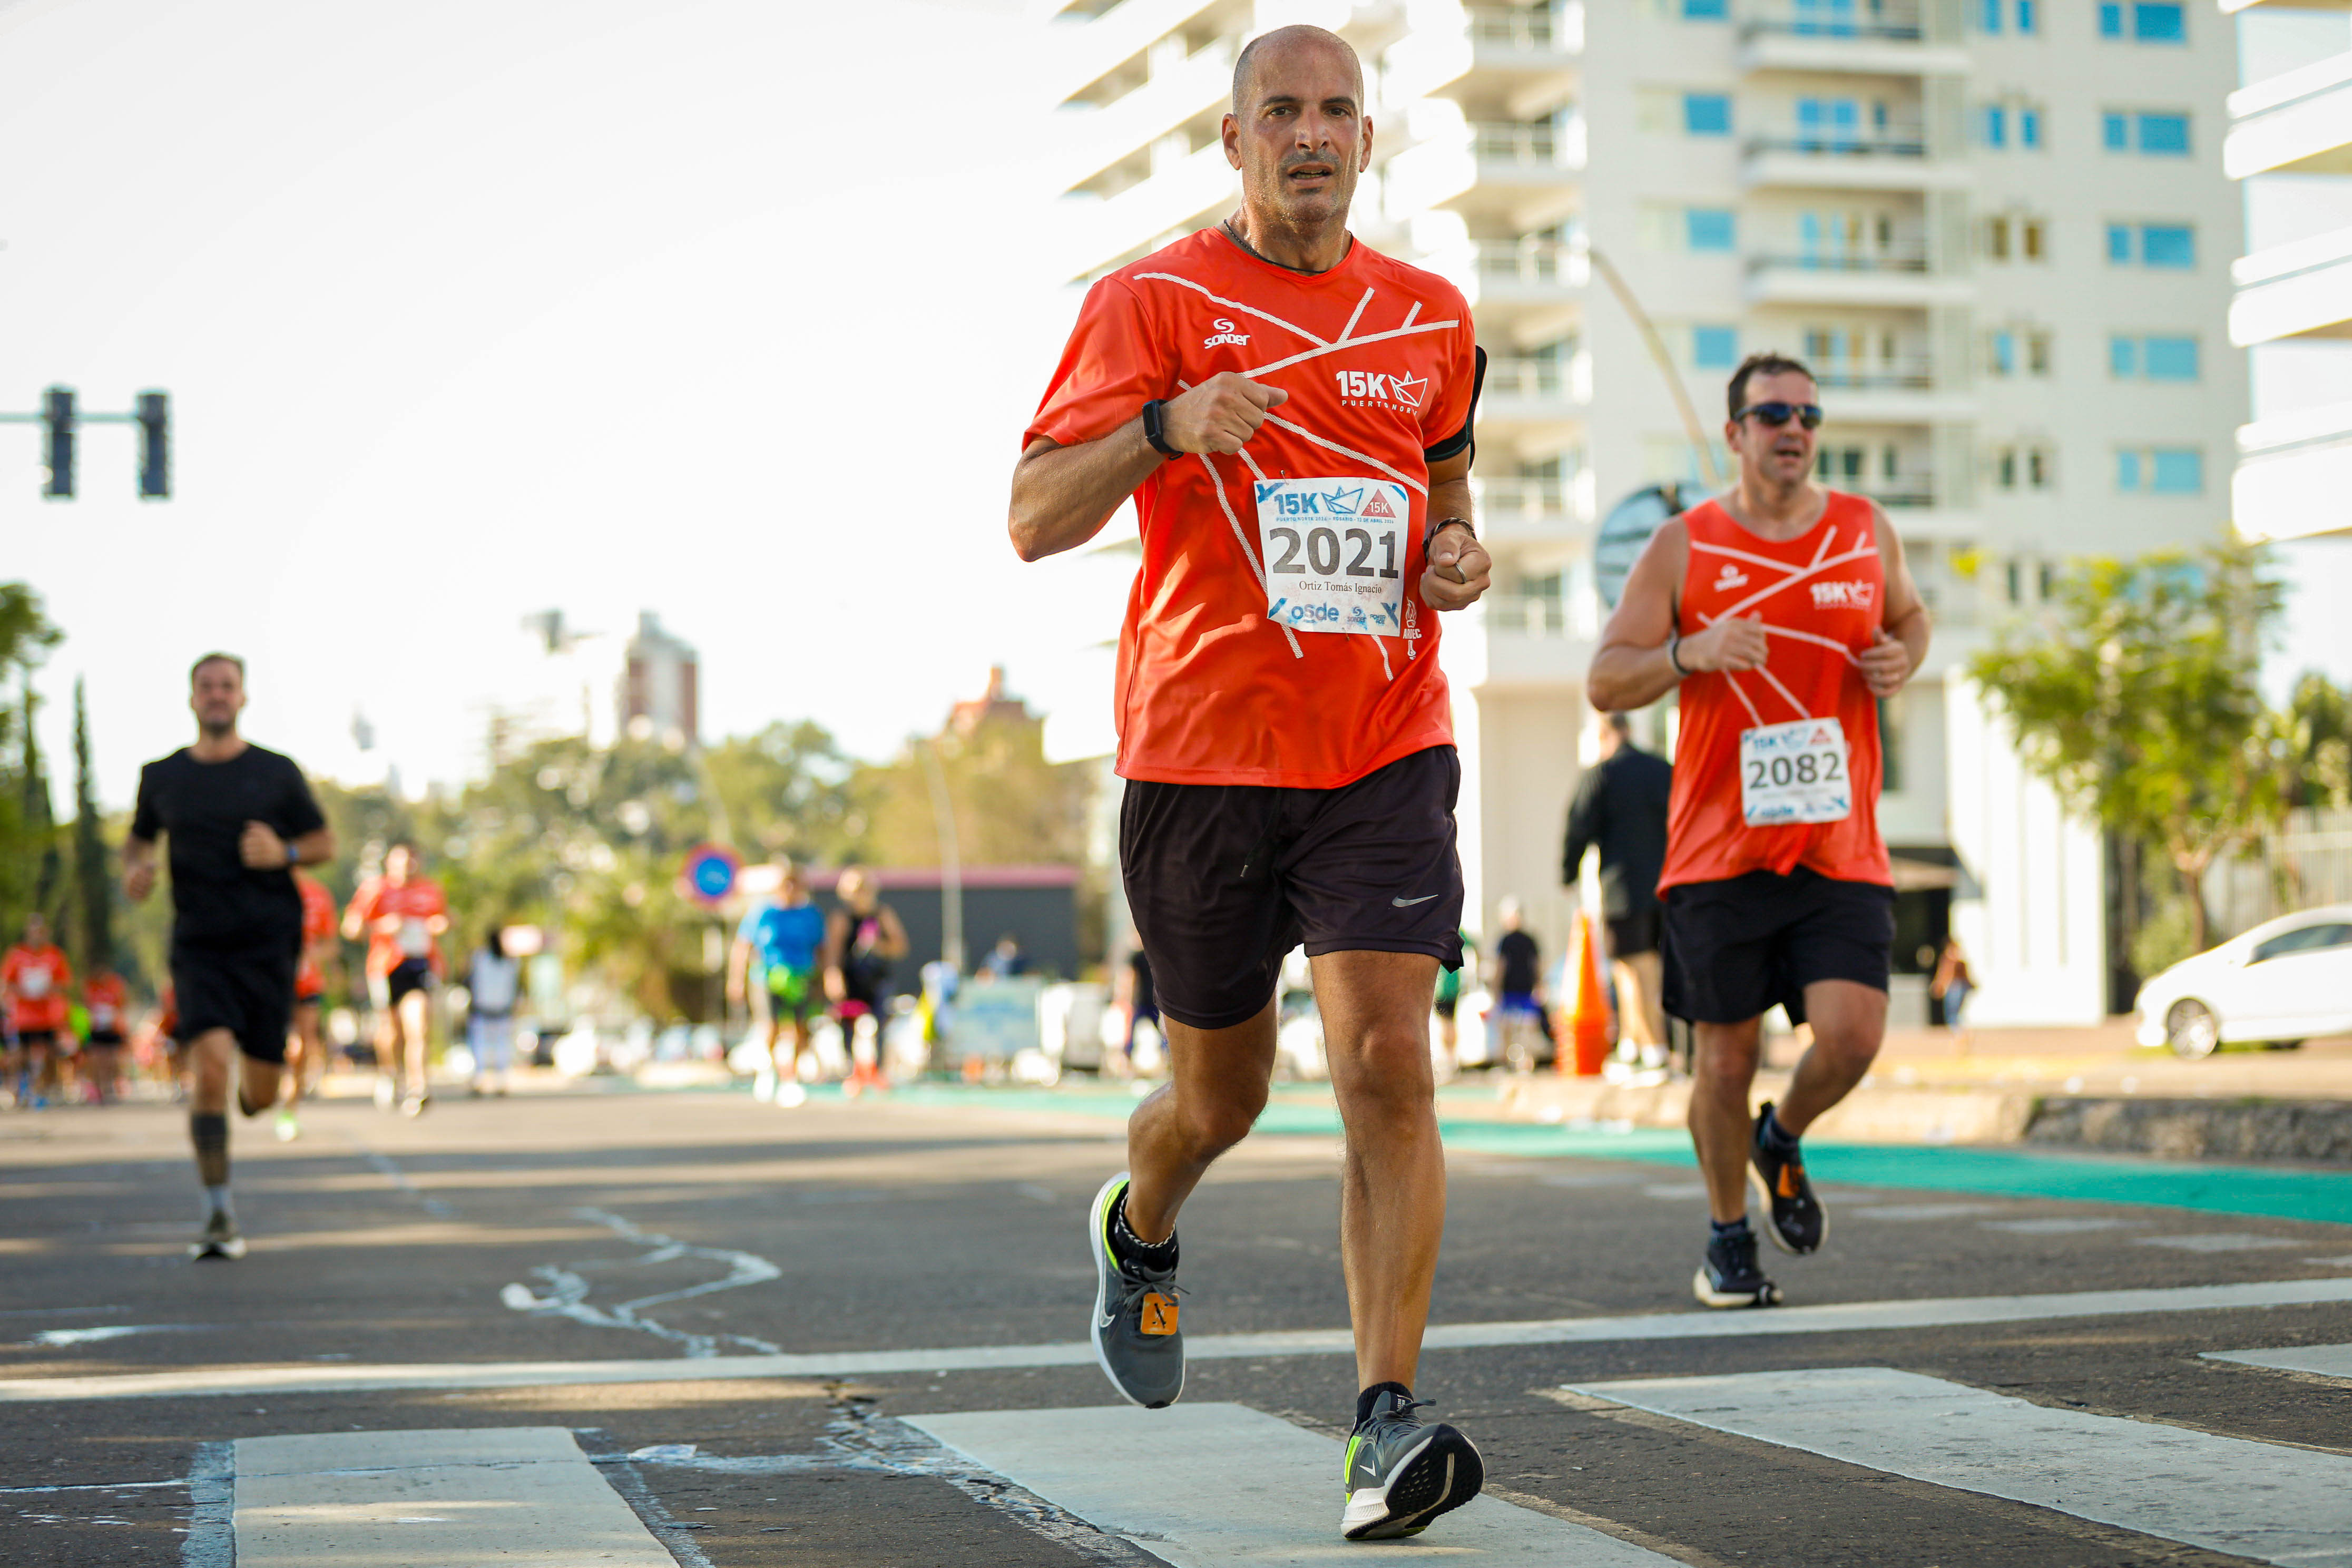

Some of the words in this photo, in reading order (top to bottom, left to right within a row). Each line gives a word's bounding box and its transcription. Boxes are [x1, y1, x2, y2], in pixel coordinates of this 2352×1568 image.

[1336, 370, 1388, 399] 15K
[1274, 493, 1319, 514] 15K
[1369, 501, 1389, 514] 15K
[1269, 527, 1398, 579] 2021
[1299, 581, 1322, 591] Ortiz
[1324, 581, 1353, 592] Tomás
[1355, 583, 1382, 595] Ignacio
[1291, 602, 1339, 621] osde
[1748, 750, 1843, 789] 2082
